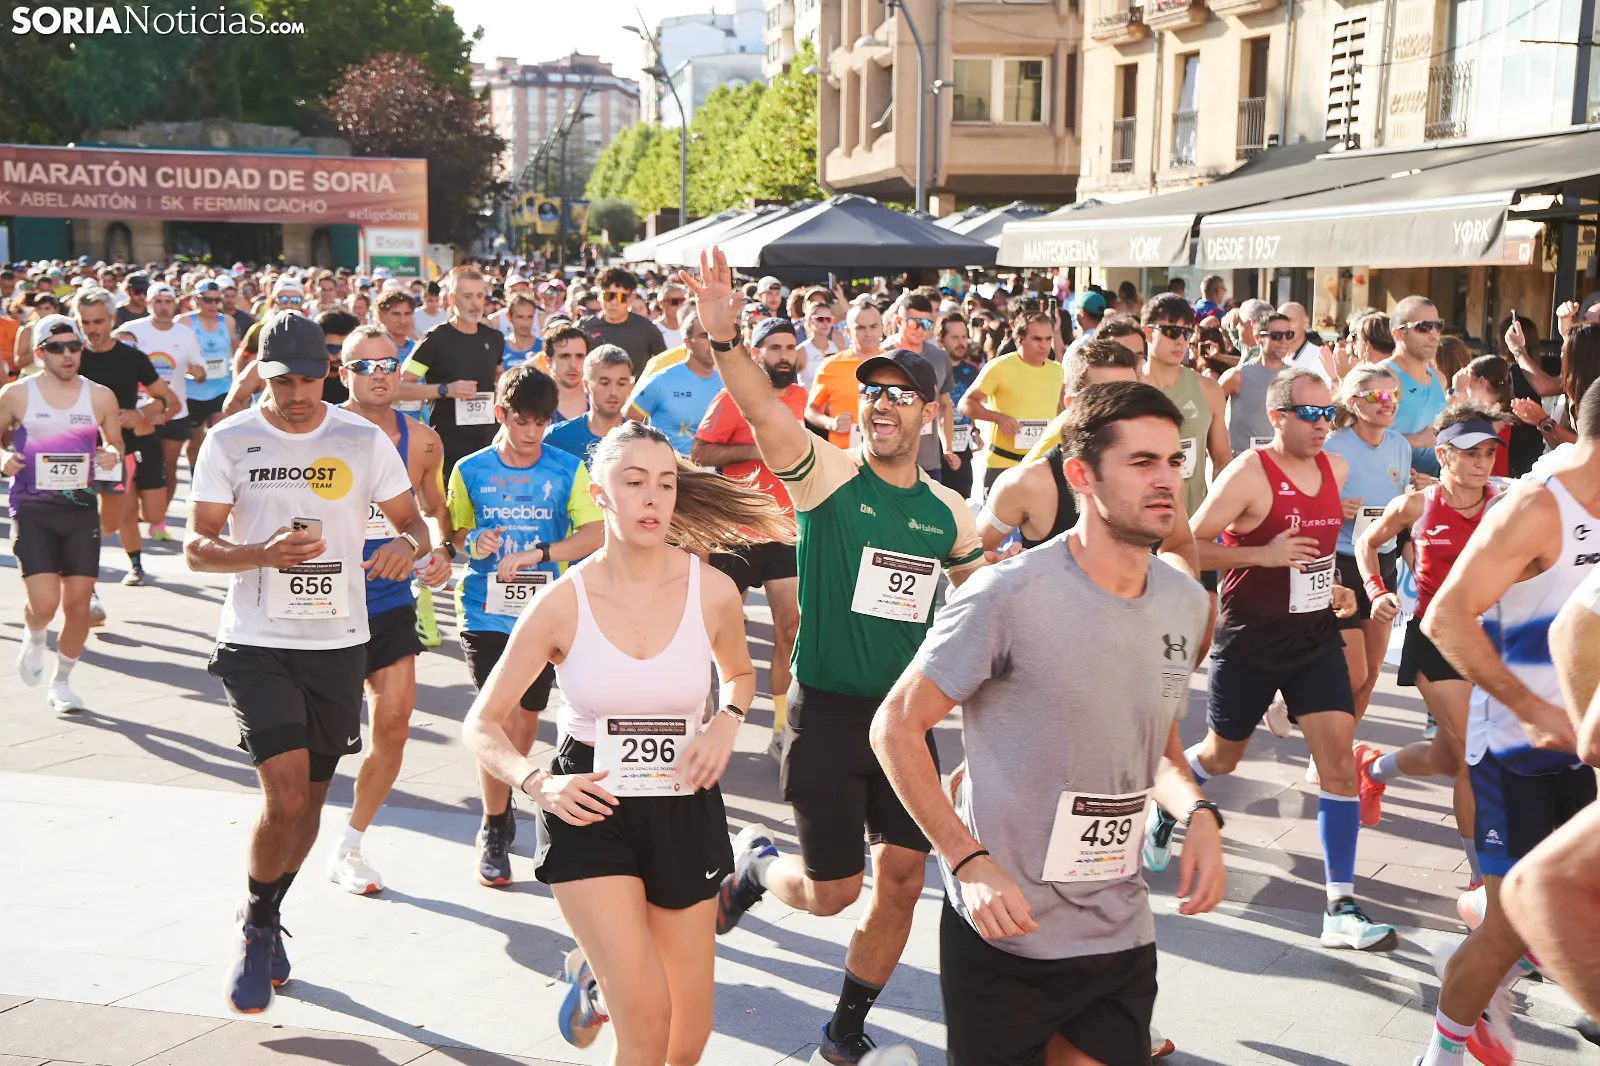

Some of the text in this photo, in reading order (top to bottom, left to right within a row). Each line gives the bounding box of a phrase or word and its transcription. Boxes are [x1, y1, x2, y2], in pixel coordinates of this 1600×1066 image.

[3, 160, 395, 193] MARATÓN CIUDAD DE SORIA
[20, 192, 68, 208] ABEL
[71, 191, 137, 209] ANTÓN
[161, 196, 184, 211] 5K
[193, 195, 260, 212] FERMÍN
[263, 199, 327, 213] CACHO
[348, 208, 419, 223] #eligeSoria
[1453, 218, 1491, 245] YORK
[1129, 236, 1162, 262] YORK
[1207, 235, 1281, 260] DESDE 1957
[467, 402, 487, 412] 397
[50, 464, 78, 475] 476
[249, 467, 336, 482] TRIBOOST
[1302, 519, 1326, 527] TEATRO
[290, 576, 332, 594] 656
[888, 572, 916, 595] 92
[1310, 571, 1331, 590] 195
[505, 585, 536, 600] 551
[621, 738, 675, 763] 296
[1080, 818, 1132, 846] 439
